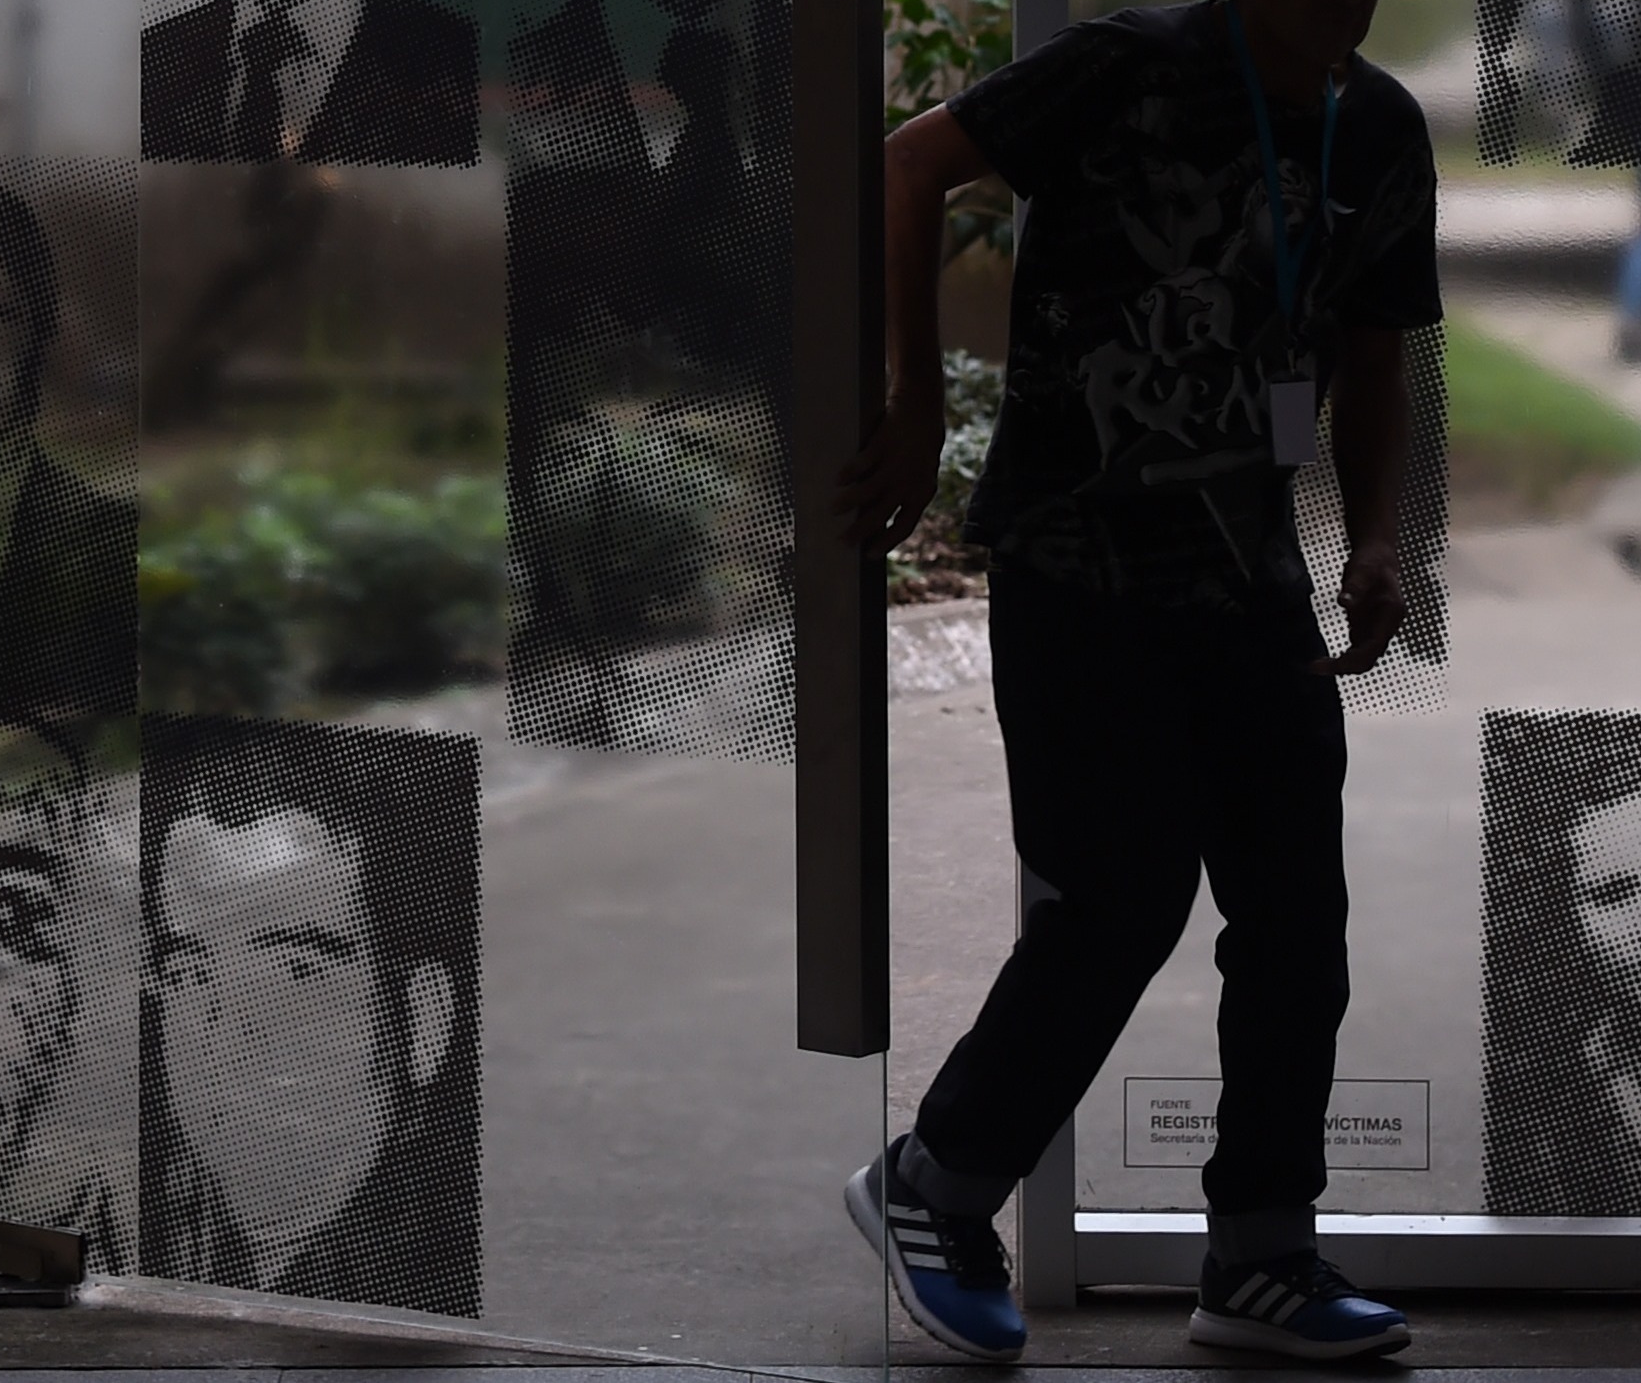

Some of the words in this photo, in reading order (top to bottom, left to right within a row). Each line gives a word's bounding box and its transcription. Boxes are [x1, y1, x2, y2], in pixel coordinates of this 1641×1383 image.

[1151, 1100, 1192, 1109] FUENTE
[1324, 1114, 1402, 1131] VÍCTIMAS
[1334, 1136, 1348, 1145] de
[1351, 1135, 1360, 1145] la
[1363, 1135, 1401, 1145] Nación
